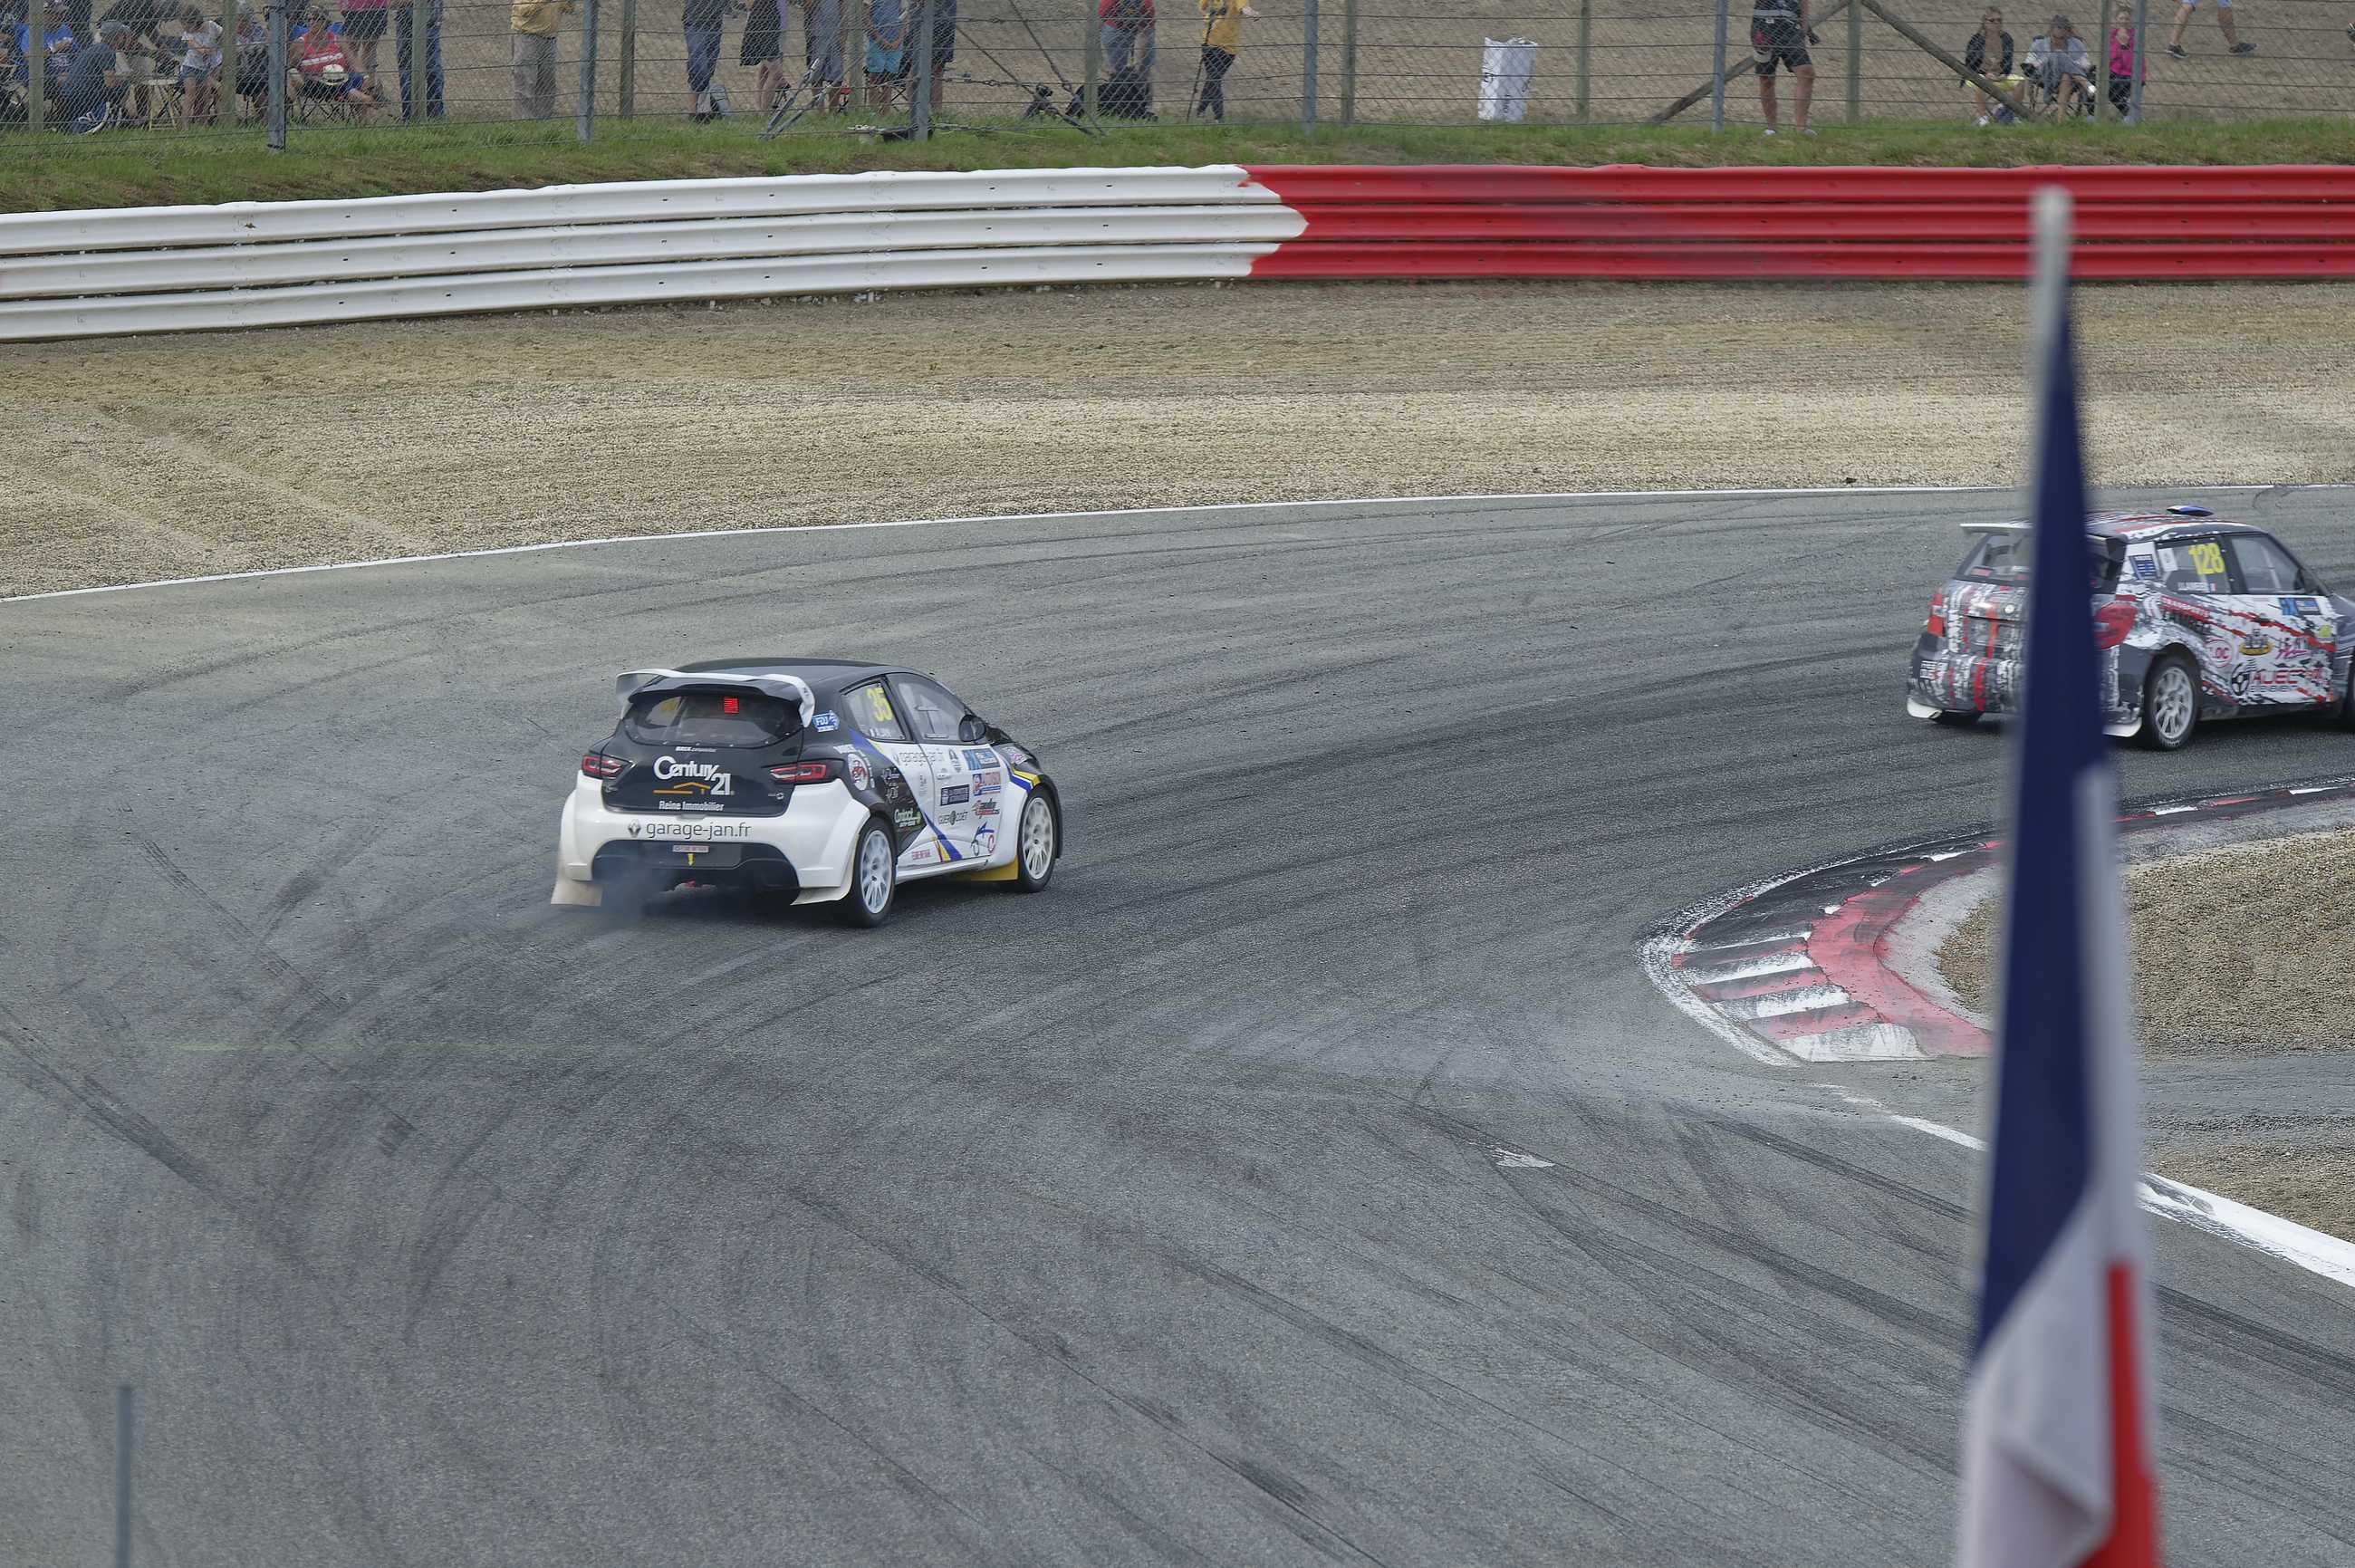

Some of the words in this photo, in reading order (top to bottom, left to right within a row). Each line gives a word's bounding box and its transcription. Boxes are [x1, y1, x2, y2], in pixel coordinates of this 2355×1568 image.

[2188, 542, 2225, 575] 128
[654, 755, 720, 781] Century
[710, 773, 732, 796] 21
[658, 800, 681, 811] Reine
[682, 801, 725, 812] Immobilier
[646, 822, 753, 841] garage-jan.fr
